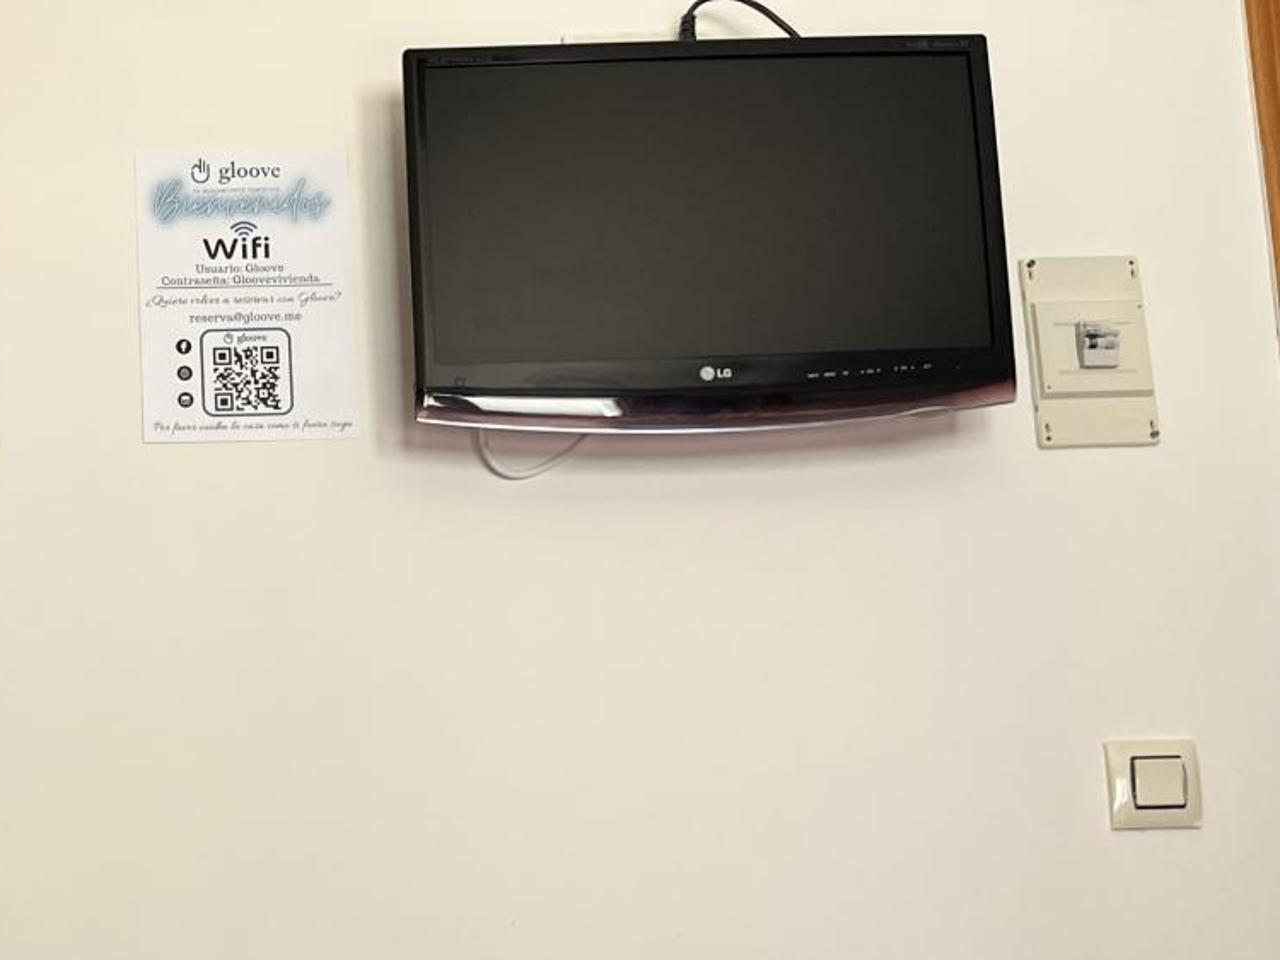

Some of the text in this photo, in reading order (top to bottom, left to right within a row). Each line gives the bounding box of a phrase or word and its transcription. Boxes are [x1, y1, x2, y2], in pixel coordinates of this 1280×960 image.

[218, 161, 281, 184] gloove
[203, 237, 270, 260] Wifi
[195, 262, 284, 275] Usuario: Gloove
[189, 312, 302, 324] reserva@gloove.me
[237, 333, 267, 345] gloove
[716, 367, 732, 379] LG
